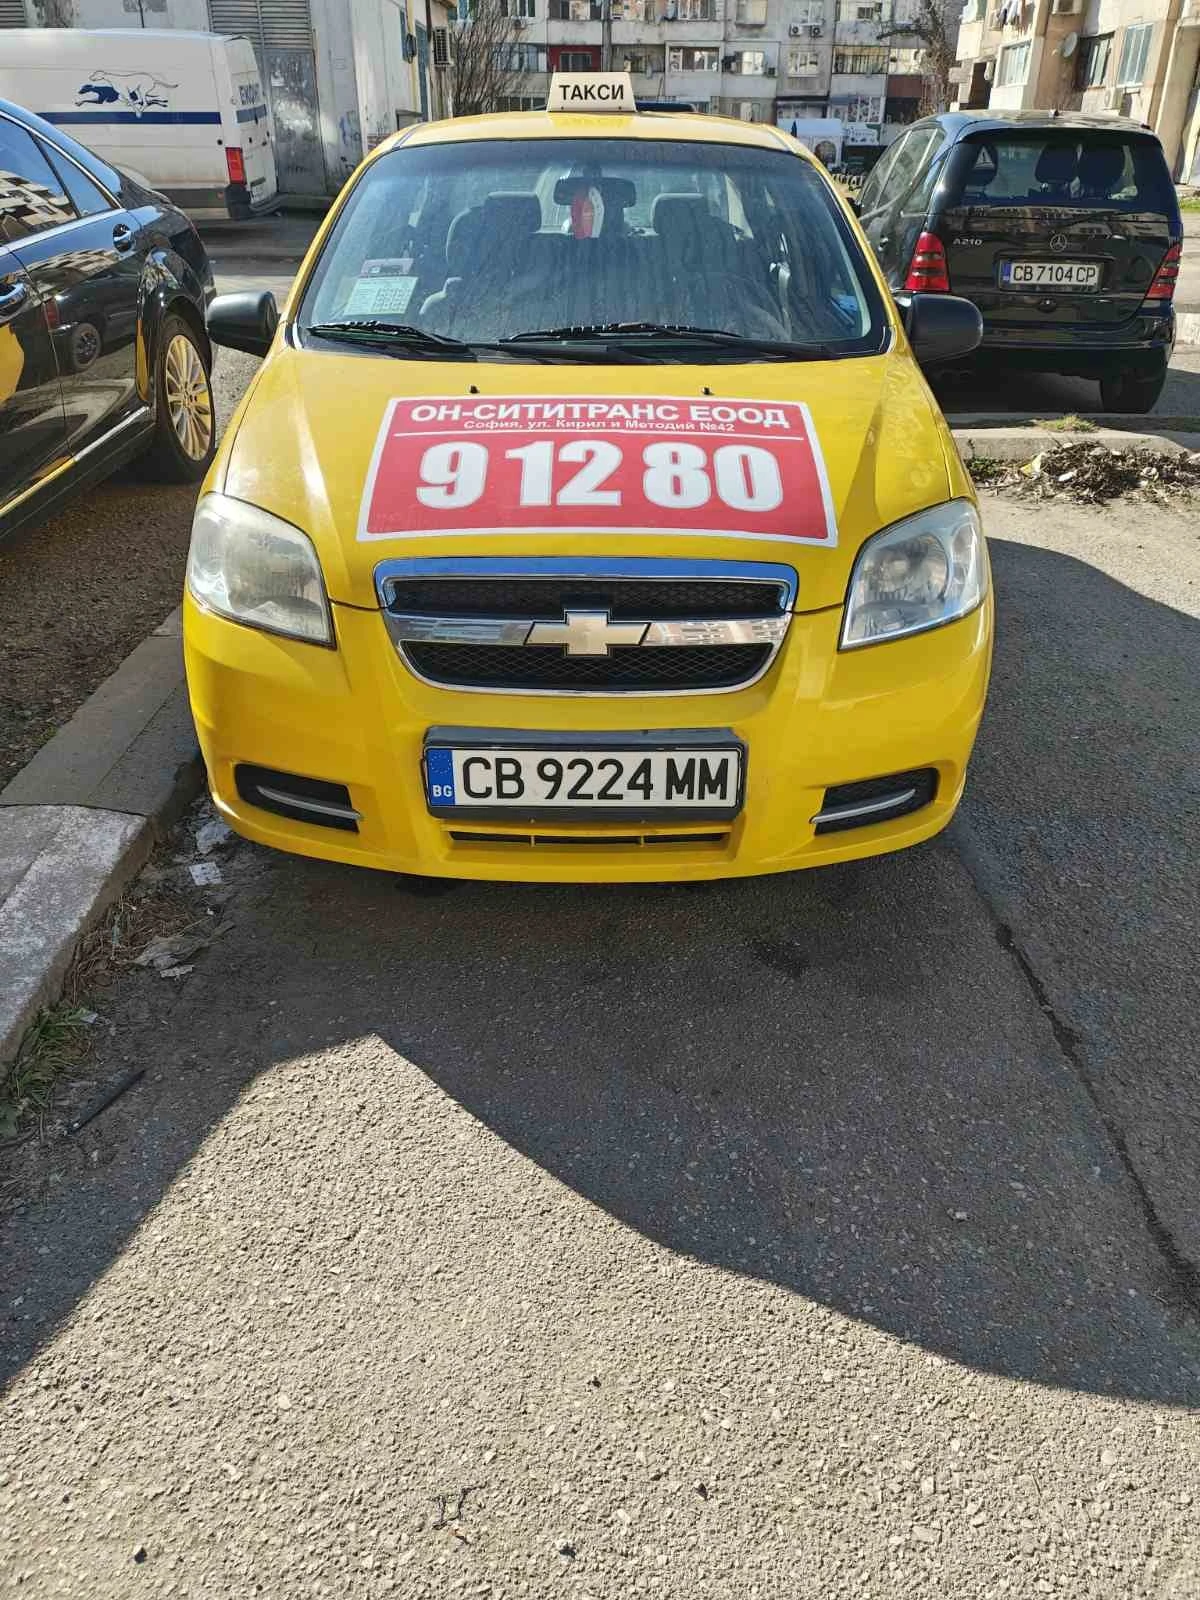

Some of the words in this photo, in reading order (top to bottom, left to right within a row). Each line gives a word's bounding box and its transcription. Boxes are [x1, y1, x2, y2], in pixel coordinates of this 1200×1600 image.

[559, 84, 624, 100] ТАКСИ
[953, 237, 982, 246] A210
[1013, 265, 1033, 281] CB
[1036, 266, 1073, 282] 7104
[1076, 267, 1096, 282] CP
[411, 403, 679, 421] ОН-СИТИТРАНС
[690, 405, 790, 429] ЕООД
[527, 422, 551, 430] ул.
[556, 419, 610, 431] Кирил
[613, 421, 620, 429] и
[626, 420, 695, 430] Методий
[700, 422, 735, 431] №42
[415, 441, 488, 509] 9
[505, 440, 622, 506] 12
[643, 442, 783, 512] 80
[463, 757, 525, 799] CB
[537, 758, 653, 801] 9224
[666, 758, 728, 800] MM
[432, 786, 453, 798] BG
